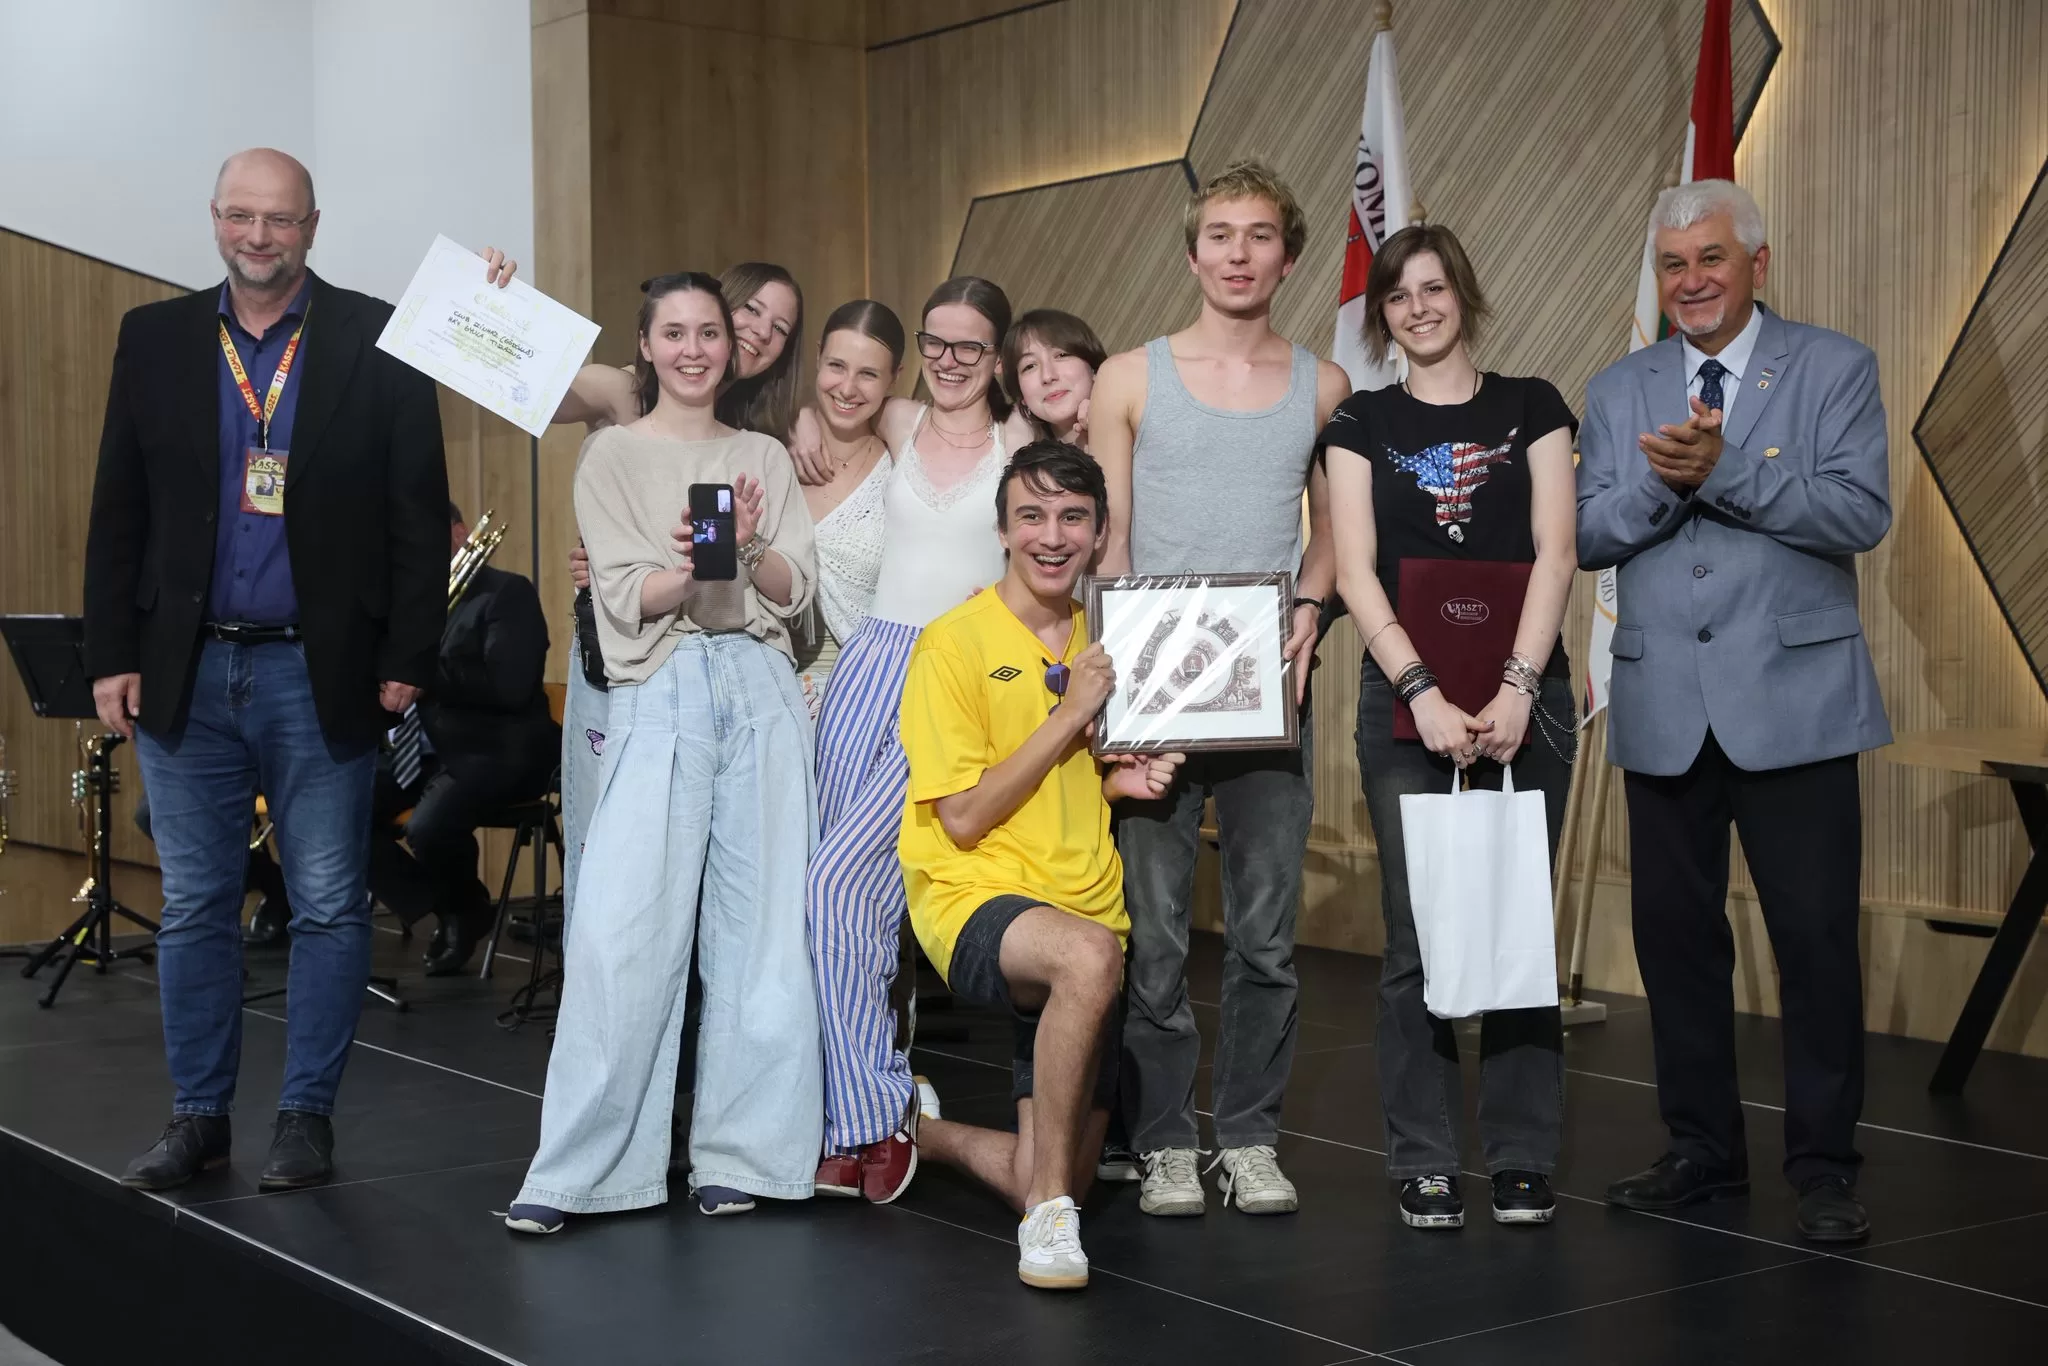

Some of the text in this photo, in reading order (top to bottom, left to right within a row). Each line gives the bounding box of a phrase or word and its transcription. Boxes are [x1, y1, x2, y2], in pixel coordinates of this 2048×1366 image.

[279, 344, 298, 373] KASZT
[241, 386, 260, 415] KASZT
[1455, 603, 1483, 613] KASZT
